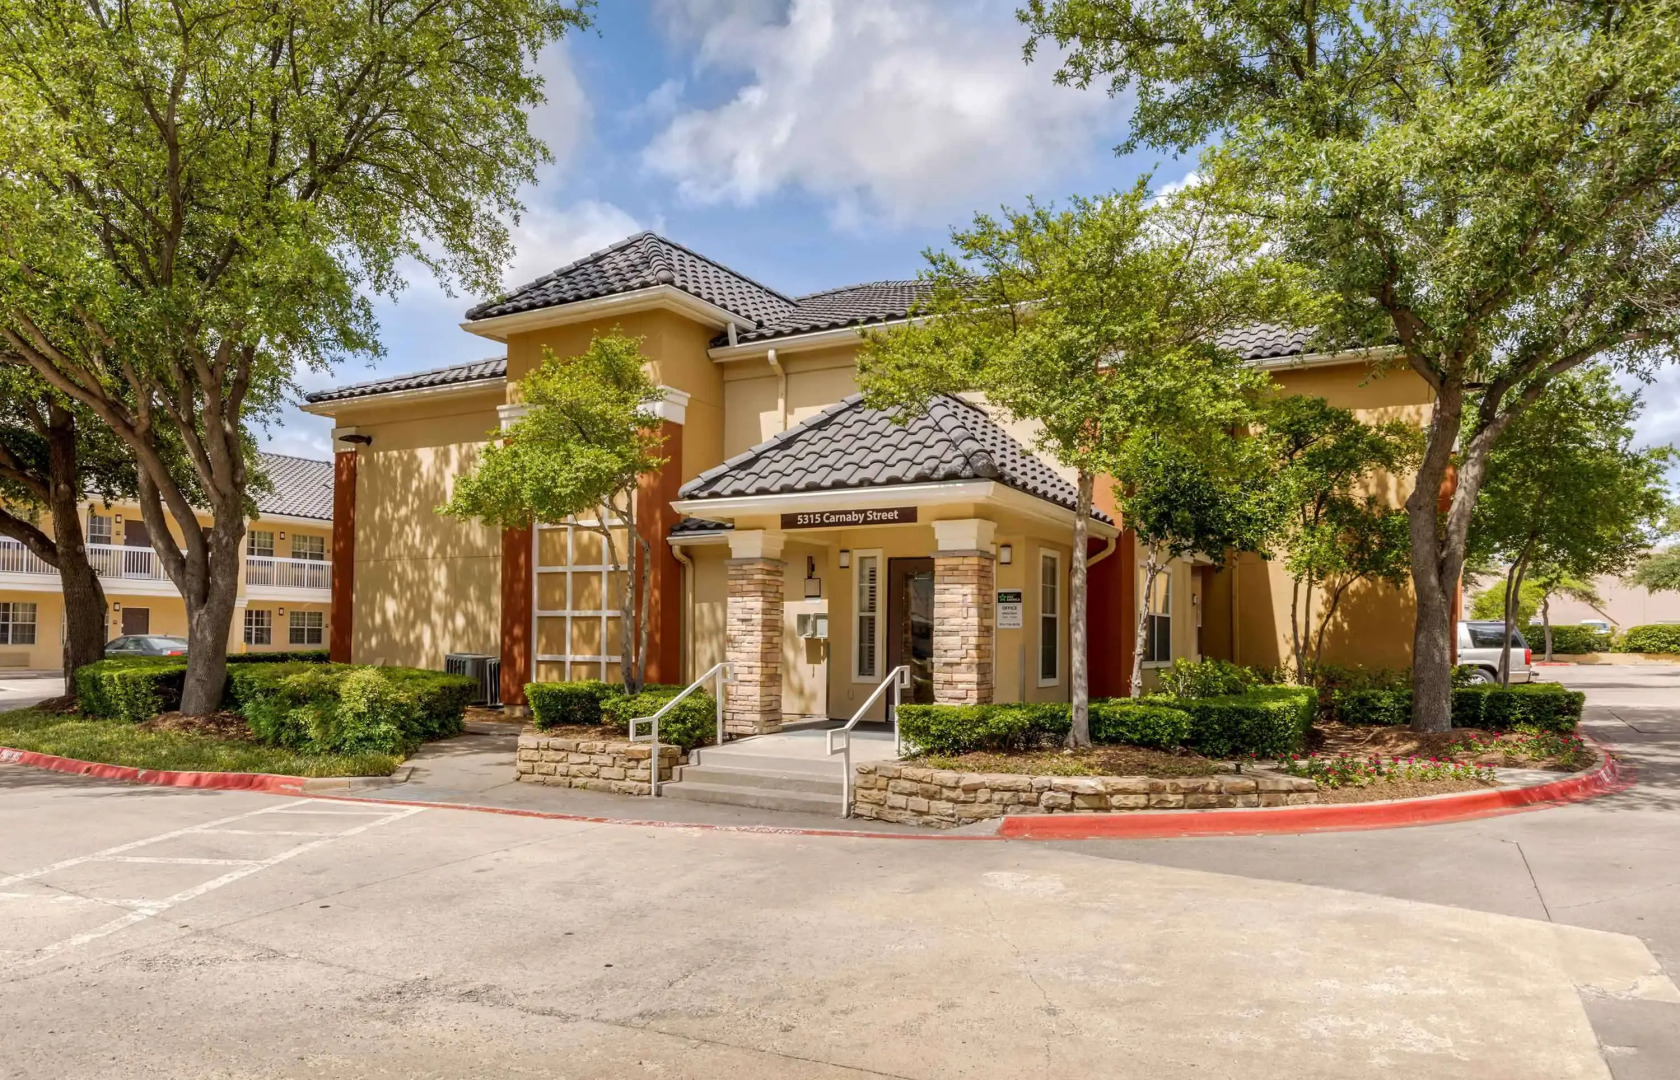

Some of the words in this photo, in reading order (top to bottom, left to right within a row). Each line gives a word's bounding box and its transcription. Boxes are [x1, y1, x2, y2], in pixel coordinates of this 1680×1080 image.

[797, 513, 821, 525] 5315
[823, 511, 865, 524] Carnaby
[866, 510, 899, 521] Street
